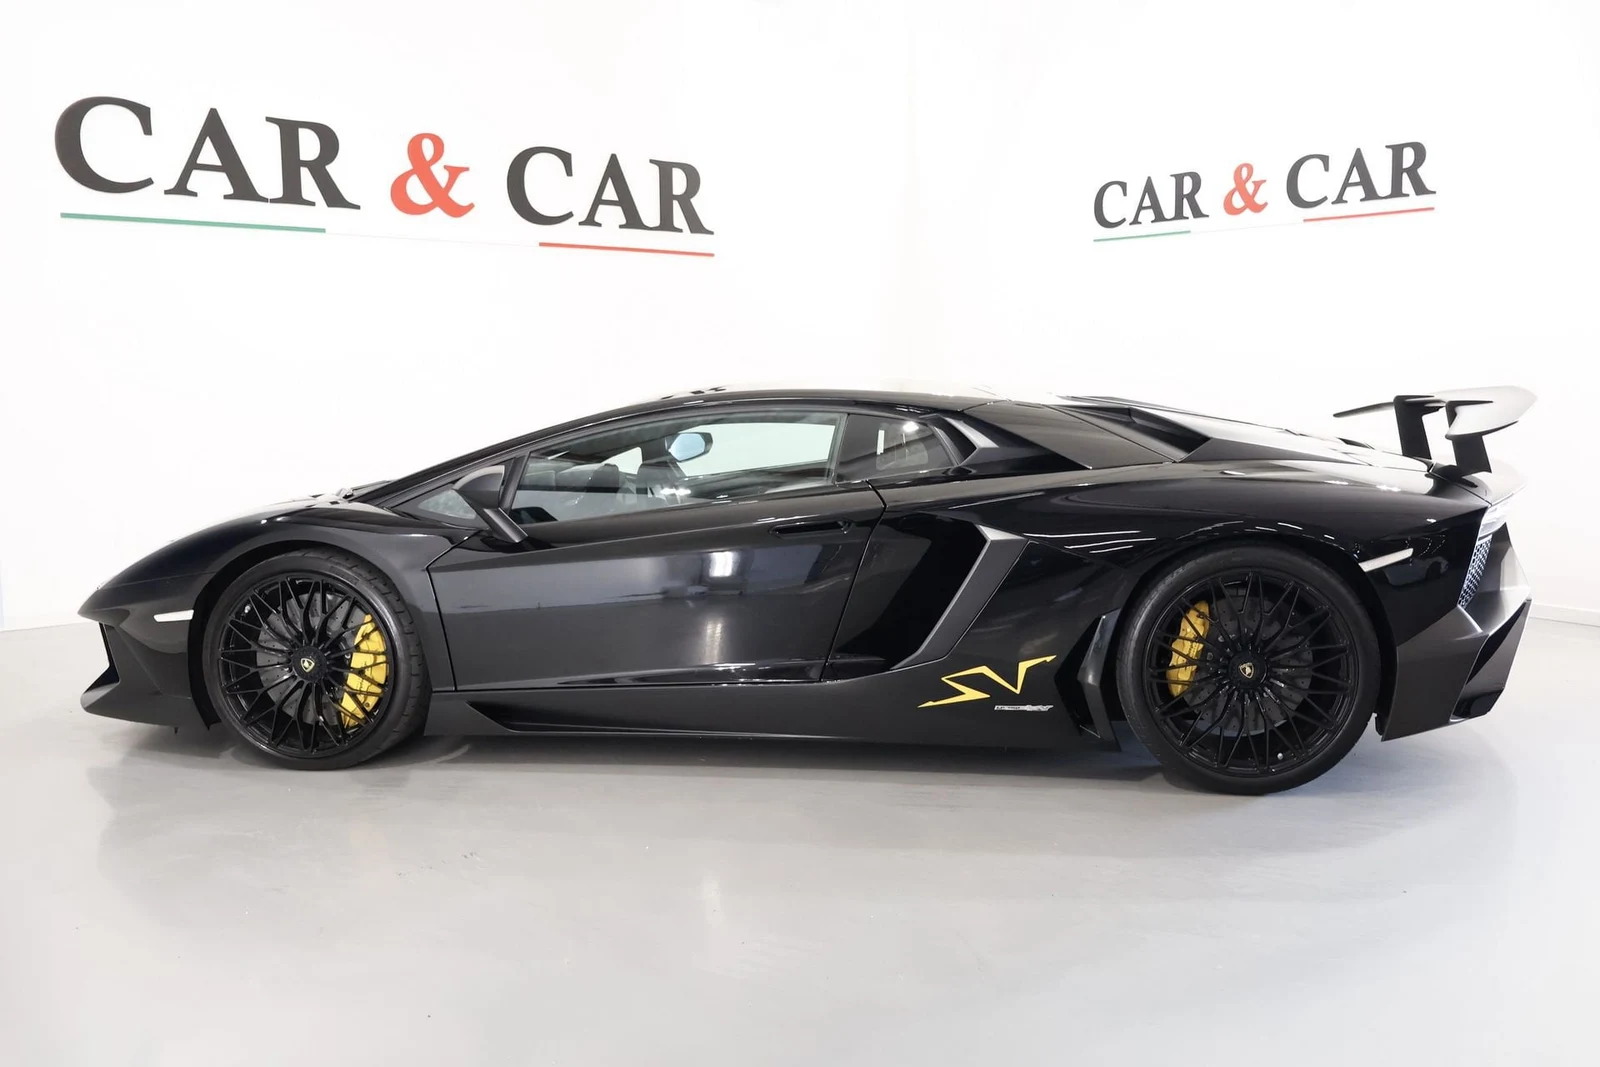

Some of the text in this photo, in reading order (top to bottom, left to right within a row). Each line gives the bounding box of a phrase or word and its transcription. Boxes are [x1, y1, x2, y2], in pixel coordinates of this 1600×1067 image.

[55, 97, 714, 235] CAR & CAR
[1094, 141, 1437, 228] CAR & CAR
[917, 654, 1057, 708] SV
